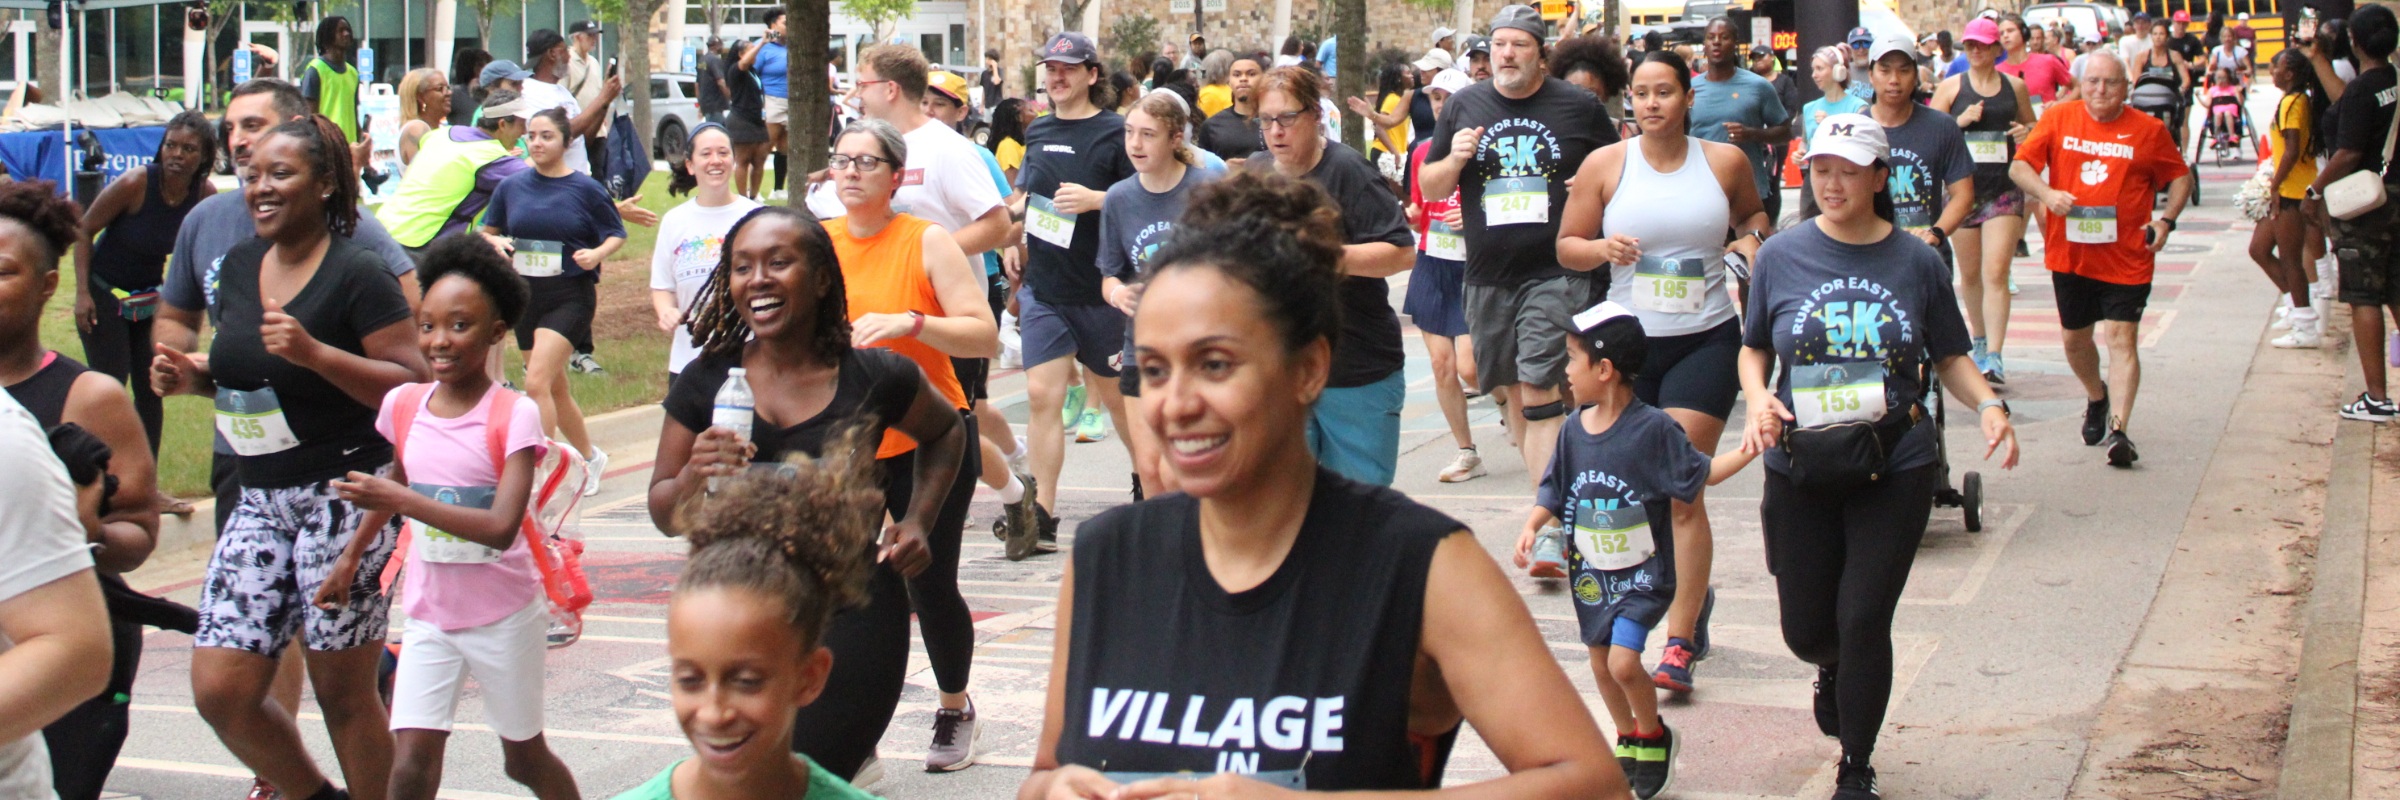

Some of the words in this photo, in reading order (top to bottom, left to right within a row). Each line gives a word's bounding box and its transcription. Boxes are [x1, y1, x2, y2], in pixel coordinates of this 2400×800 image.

[1477, 135, 1491, 161] RUN
[1487, 119, 1511, 137] FOR
[1514, 118, 1546, 132] EAST
[1542, 130, 1561, 160] LAKE
[1829, 123, 1854, 136] M
[1498, 135, 1538, 169] 5K
[1976, 143, 1996, 154] 235
[2063, 136, 2134, 159] CLEMSON
[1891, 148, 1918, 161] EAST
[1916, 159, 1932, 186] LAKE
[1501, 196, 1531, 212] 247
[1037, 214, 1060, 233] 239
[1135, 224, 1156, 245] FOR
[2078, 222, 2103, 233] 489
[1436, 236, 1457, 250] 364
[525, 254, 548, 267] 313
[1652, 279, 1688, 299] 195
[1792, 299, 1815, 335] RUN
[1811, 278, 1845, 300] FOR
[1848, 277, 1892, 300] EAST
[1889, 299, 1912, 343] LAKE
[1825, 301, 1882, 345] 5K
[1817, 389, 1861, 413] 153
[231, 417, 265, 439] 435
[1570, 471, 1588, 497] FOR
[1589, 470, 1628, 492] EAST
[1590, 533, 1630, 554] 152
[1088, 687, 1345, 751] VILLAGE
[1216, 751, 1260, 775] IN
